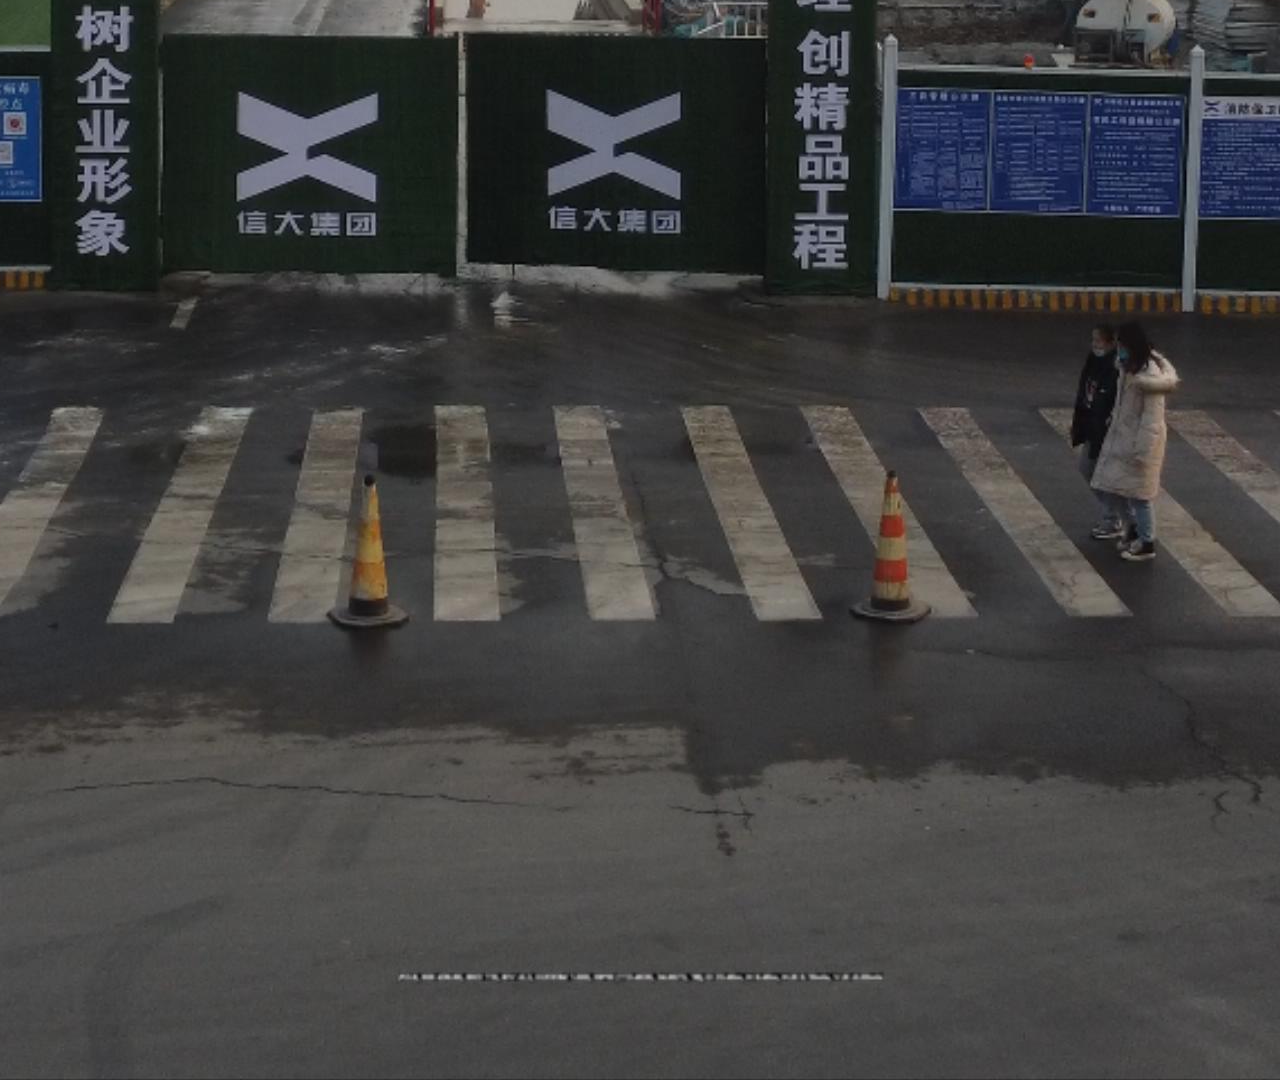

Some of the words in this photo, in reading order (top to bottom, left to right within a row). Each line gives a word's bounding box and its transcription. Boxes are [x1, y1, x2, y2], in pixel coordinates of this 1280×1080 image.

[76, 5, 133, 256] 树企业形象
[794, 30, 852, 270] 创精品工程
[236, 209, 378, 238] 信大集团
[548, 205, 682, 235] 信大集团
